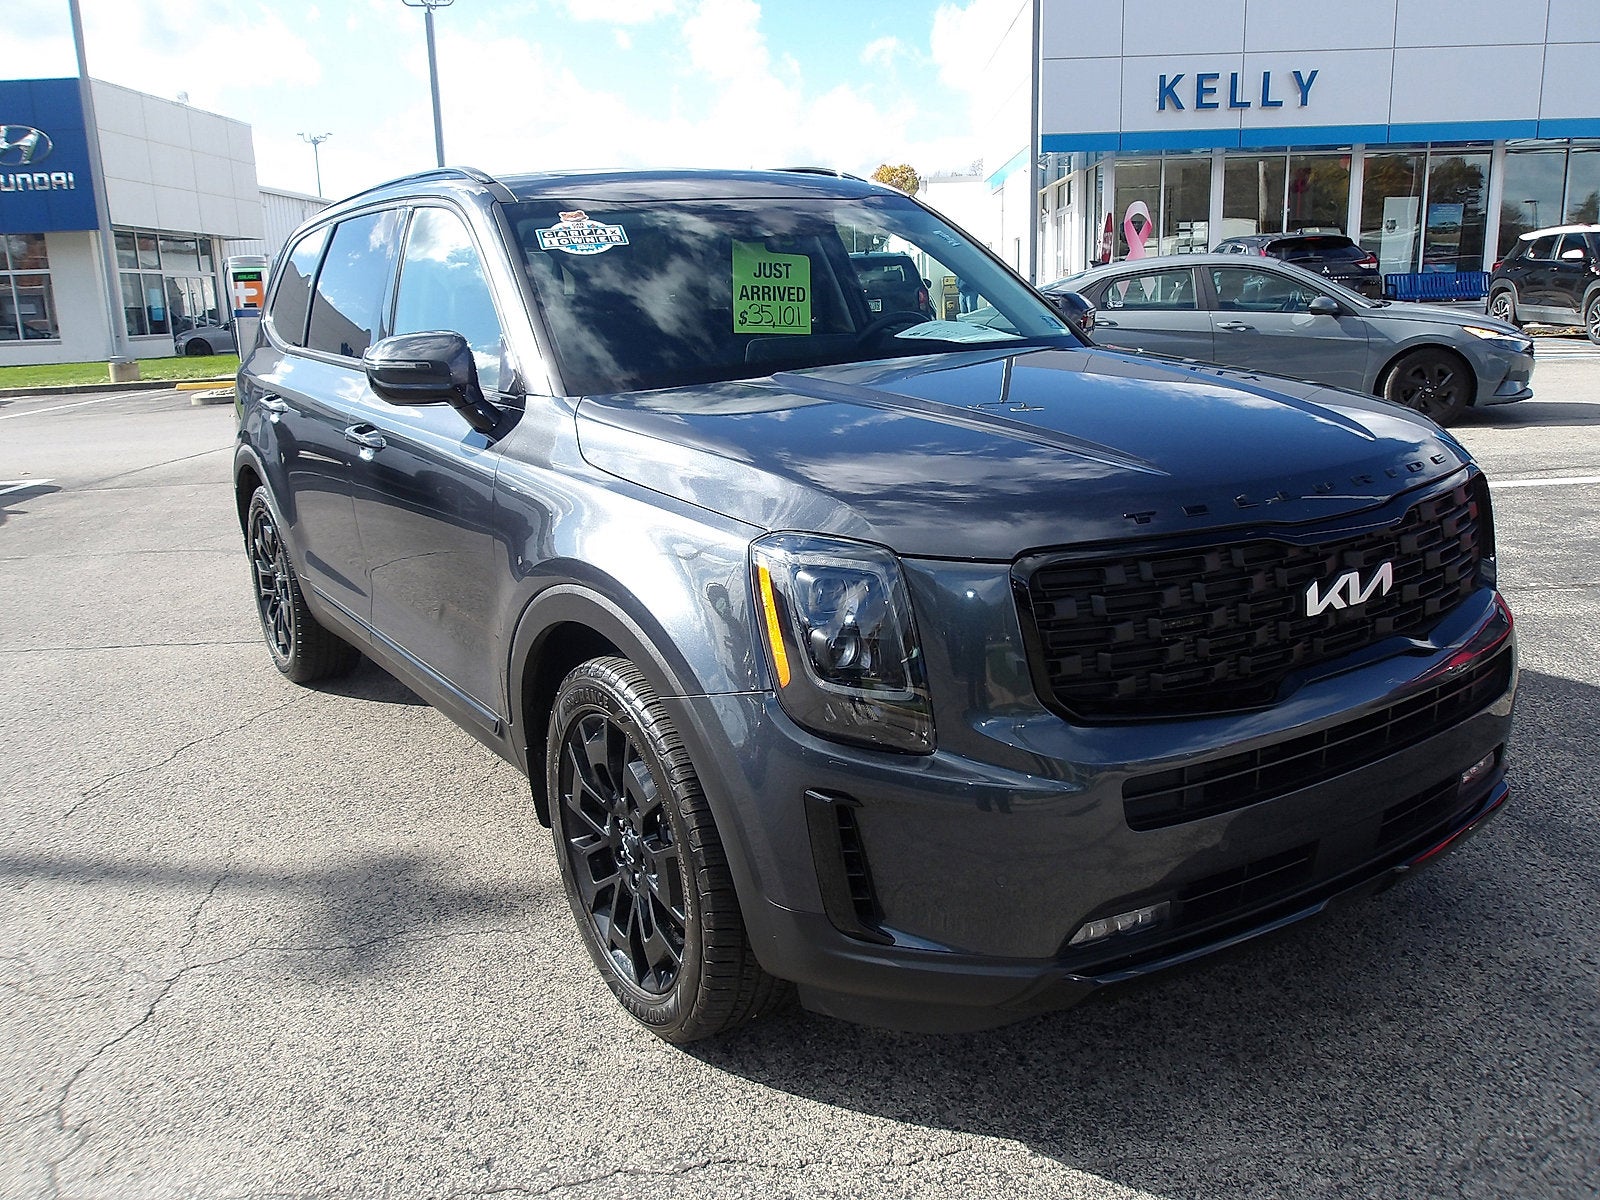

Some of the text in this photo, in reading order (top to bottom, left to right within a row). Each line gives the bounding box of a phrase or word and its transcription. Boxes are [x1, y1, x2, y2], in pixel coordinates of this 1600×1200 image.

[1157, 69, 1319, 111] KELLY
[542, 229, 617, 239] CARFAX
[558, 235, 623, 246] OWNER
[753, 262, 792, 279] JUST
[738, 285, 806, 303] ARRIVED
[738, 303, 802, 328] $35,101
[1122, 452, 1447, 525] TELLURIDE
[1306, 561, 1393, 617] KIA
